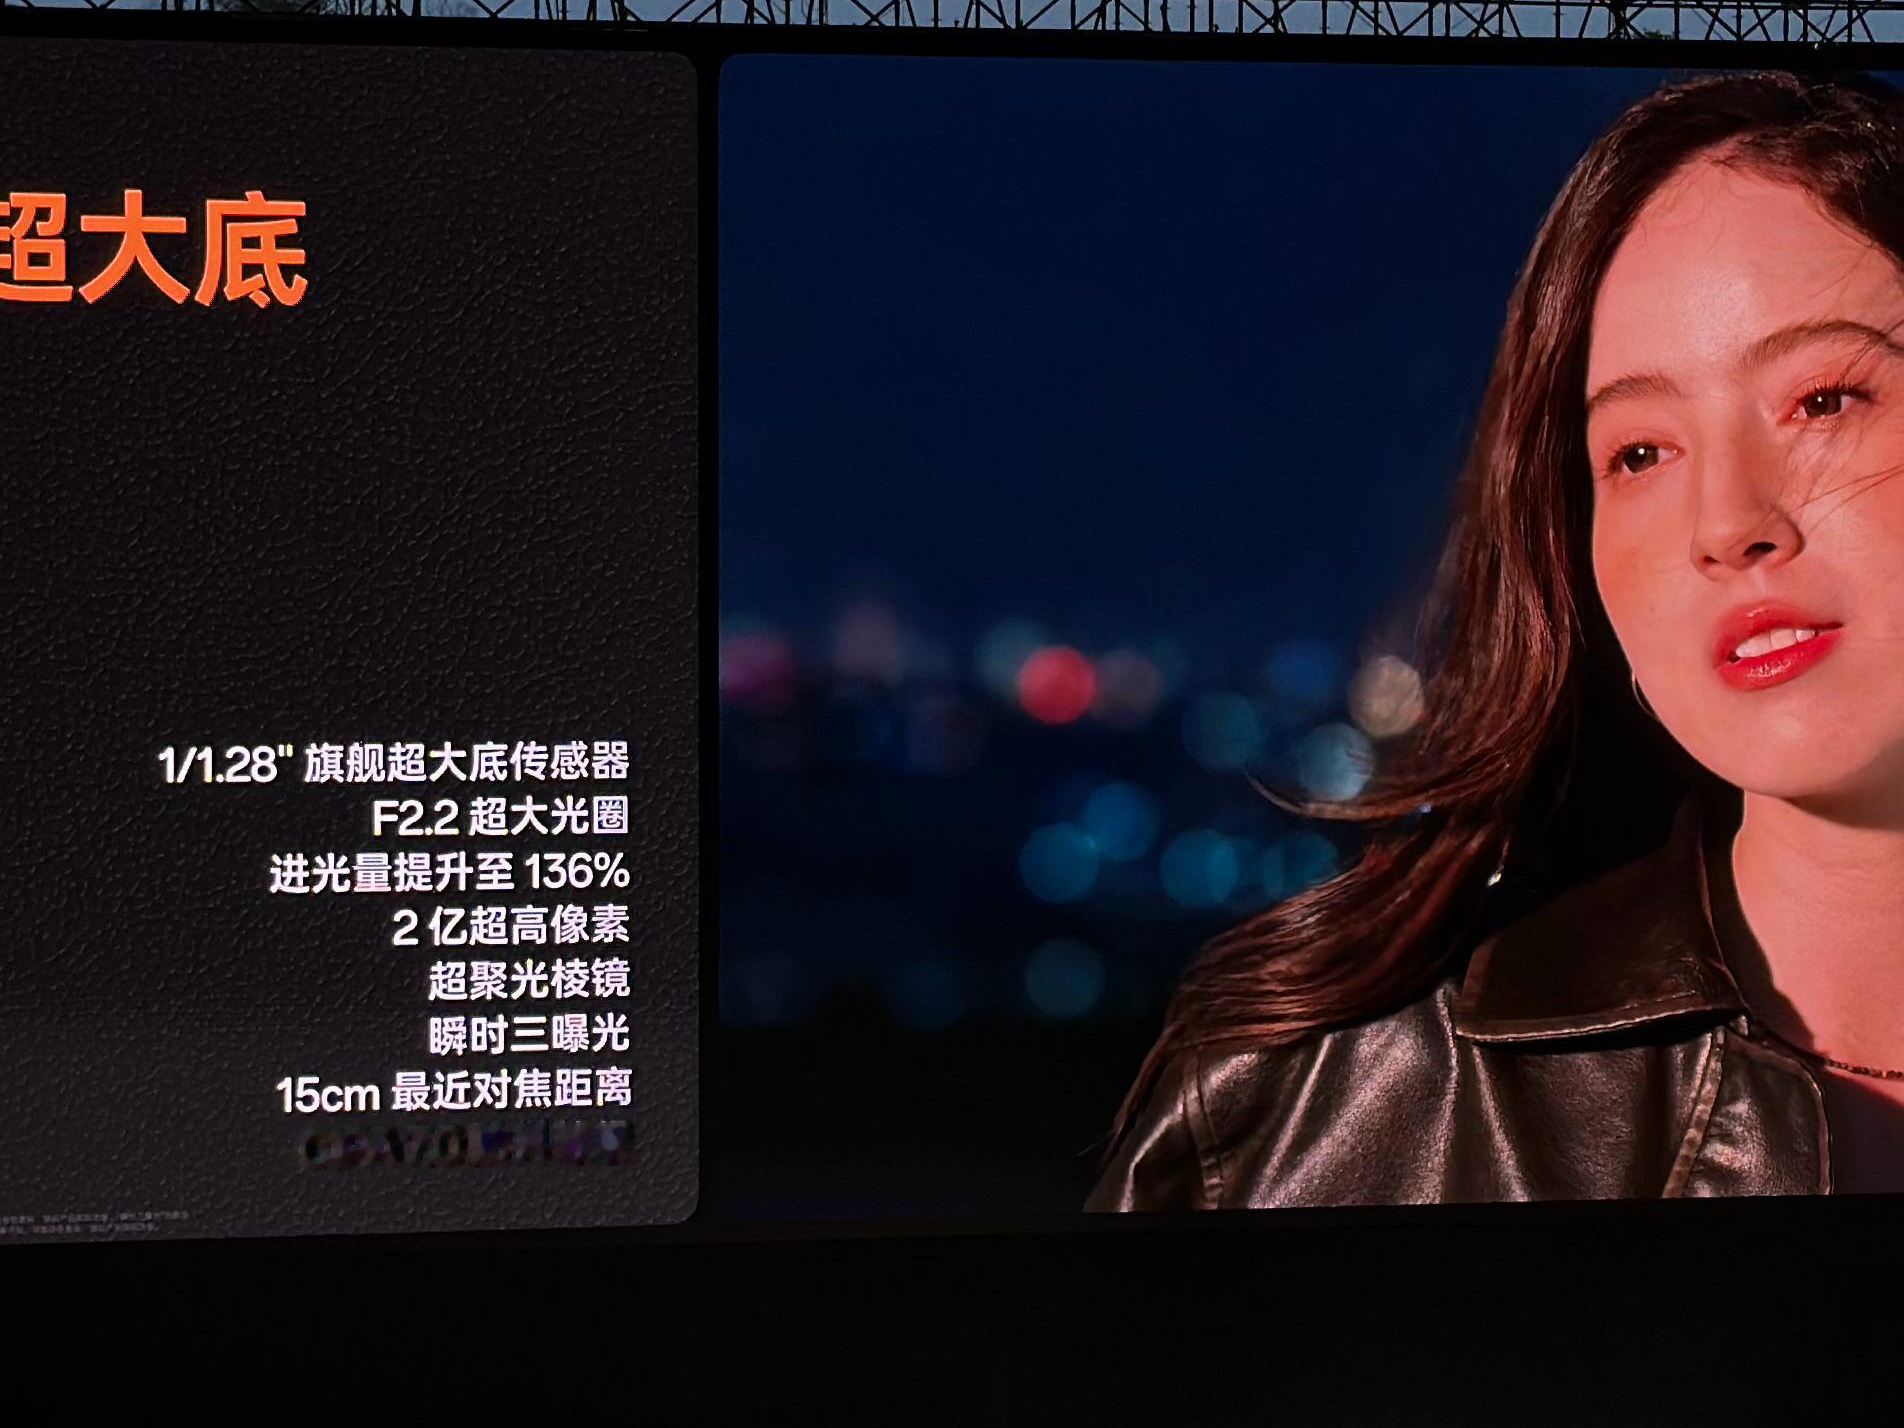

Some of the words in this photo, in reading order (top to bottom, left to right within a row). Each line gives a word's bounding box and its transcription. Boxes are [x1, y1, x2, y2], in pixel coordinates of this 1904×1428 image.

[303, 740, 630, 784] 旗舰超大底传感器
[373, 798, 460, 837] F2.2
[468, 794, 629, 837] 超大光圈
[269, 850, 515, 894] 进光量提升至
[524, 851, 631, 889] 136%
[391, 908, 419, 946] 2
[428, 902, 630, 947] 亿超高像素
[427, 956, 631, 1001] 超聚光棱镜
[429, 1011, 630, 1057] 瞬时三曝光
[275, 1075, 381, 1113] 15cm
[391, 1065, 633, 1112] 最近对焦距离
